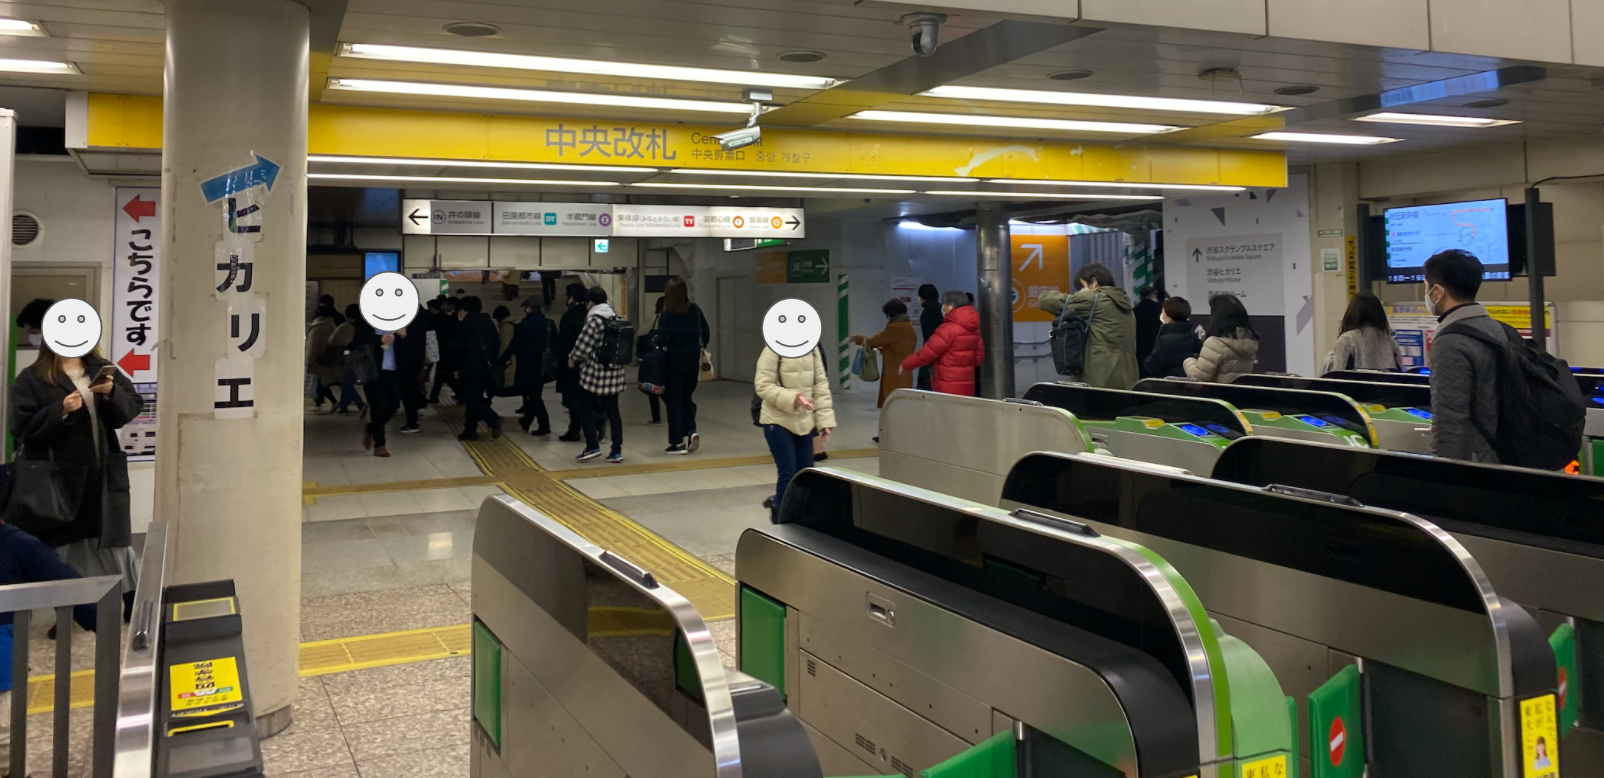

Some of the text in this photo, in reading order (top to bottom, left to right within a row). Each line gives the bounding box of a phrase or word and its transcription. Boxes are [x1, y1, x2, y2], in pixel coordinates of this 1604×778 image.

[545, 123, 676, 160] 中央改札
[692, 149, 745, 161] 中央剪票口
[756, 151, 811, 164] 중앙 개찰구
[448, 211, 481, 220] 井の頭線
[502, 211, 541, 220] 田園都市線
[567, 212, 596, 221] 半蔵門線
[703, 215, 731, 223] 副都心線
[1206, 243, 1275, 255] 渋谷スクランブルスクエア
[1206, 268, 1241, 276] 渋谷ヒカリエ
[126, 229, 154, 346] こちらです
[214, 197, 261, 409] ヒカリエ
